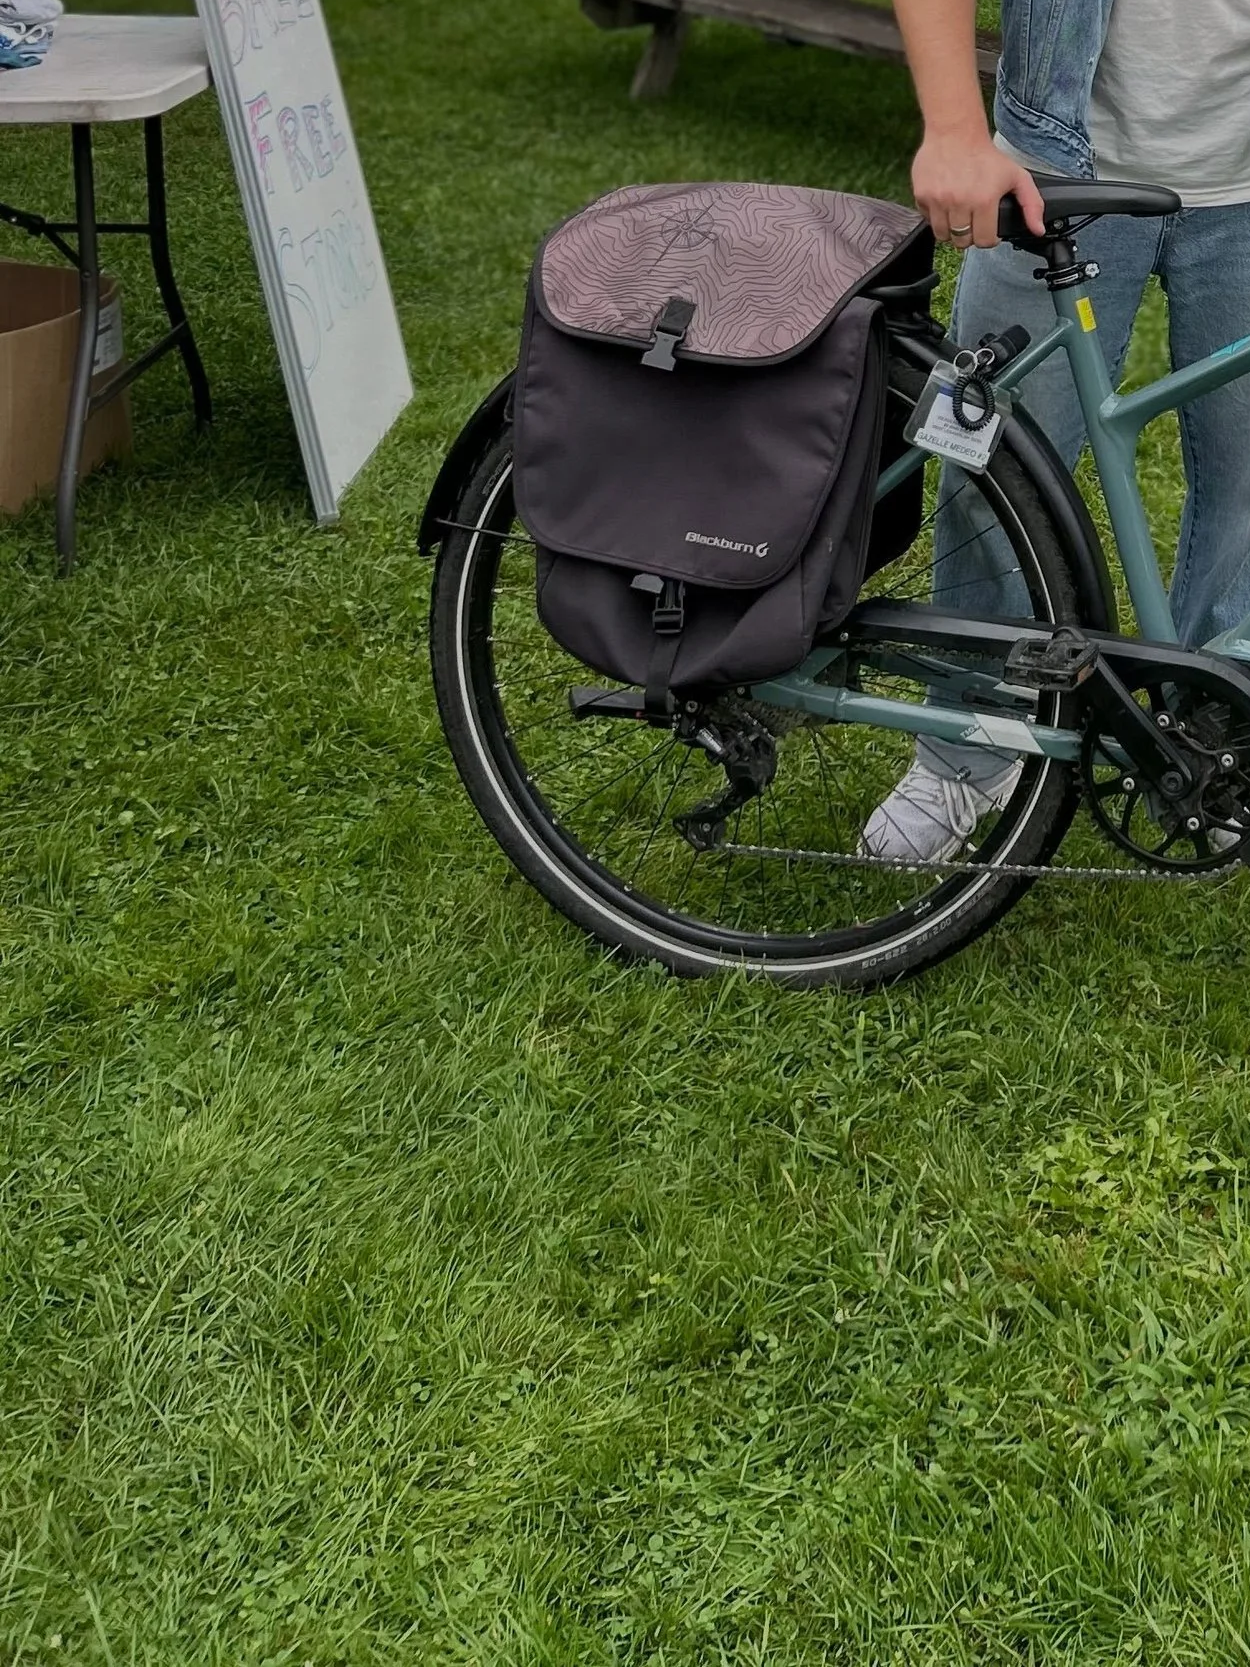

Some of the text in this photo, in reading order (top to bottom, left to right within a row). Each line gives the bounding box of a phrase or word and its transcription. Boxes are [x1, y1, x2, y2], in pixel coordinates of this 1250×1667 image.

[244, 90, 348, 195] FREE
[917, 431, 951, 449] GAZELLE
[685, 531, 754, 554] Blackburn
